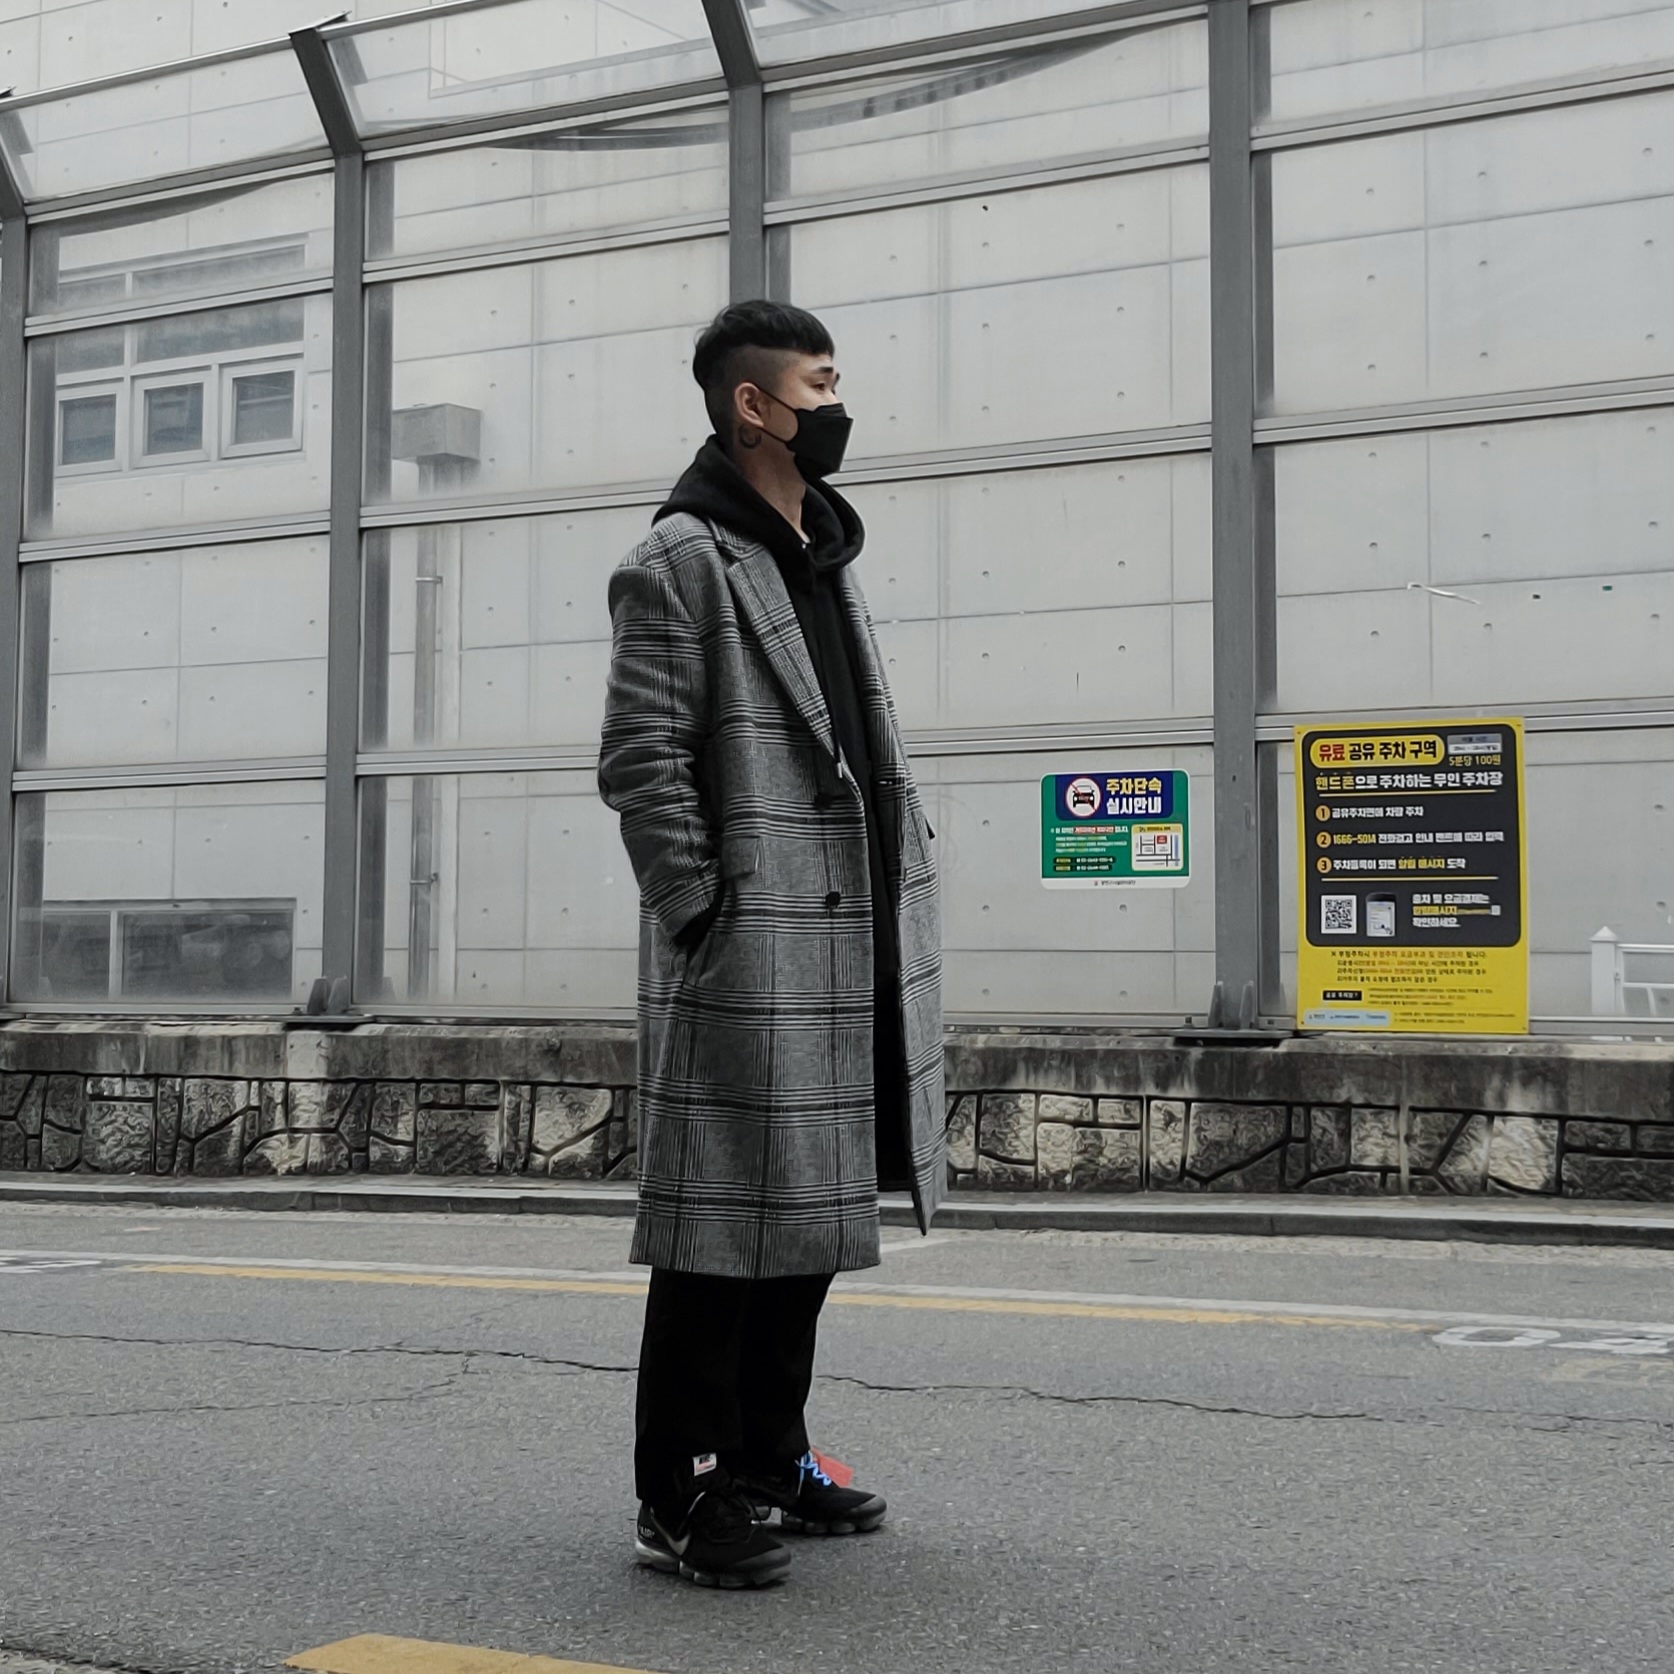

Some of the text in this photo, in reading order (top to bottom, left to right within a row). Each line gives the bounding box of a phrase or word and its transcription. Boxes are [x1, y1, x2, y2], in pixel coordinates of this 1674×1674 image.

[1319, 740, 1437, 761] 유료 공유 주차 구역
[1449, 754, 1501, 767] 5분당 100원
[1106, 777, 1162, 795] 주차단속
[1379, 773, 1431, 789] 주차하는
[1433, 773, 1461, 787] 무인
[1462, 771, 1503, 786] 주차장
[1405, 806, 1424, 817] 주차
[1333, 833, 1376, 844] 1666-5014
